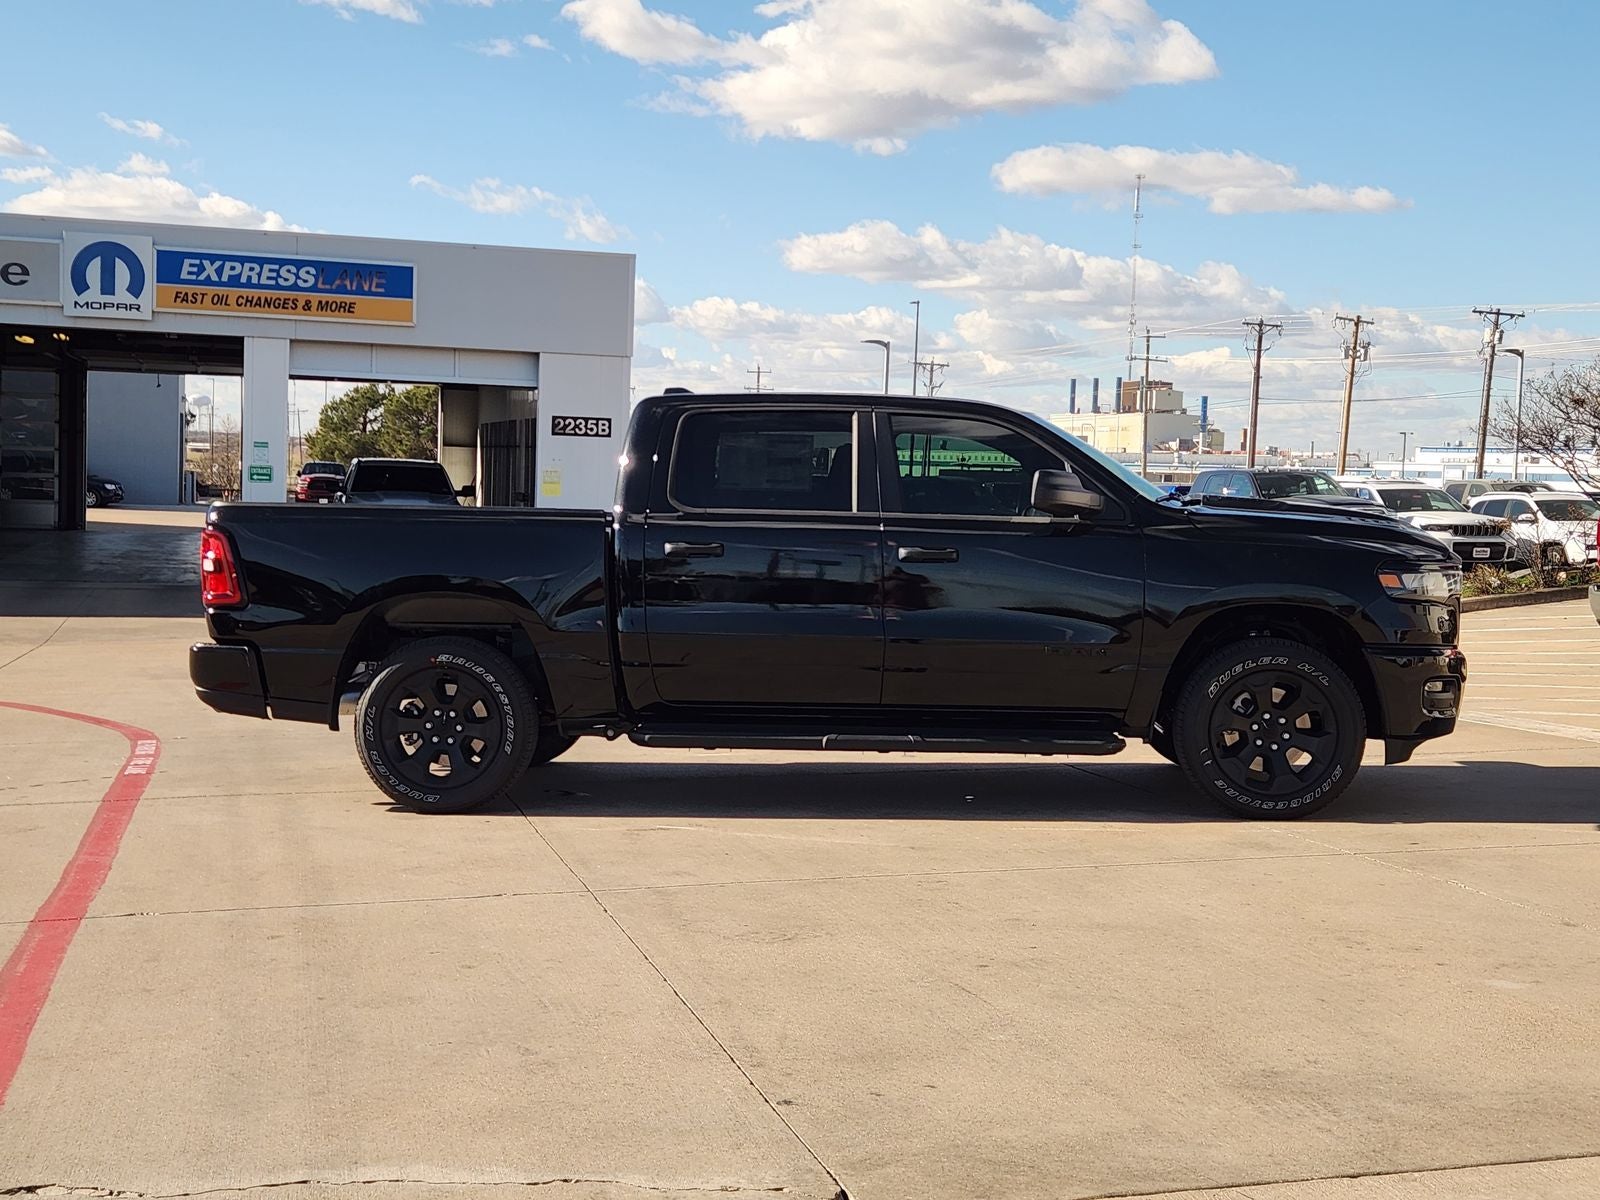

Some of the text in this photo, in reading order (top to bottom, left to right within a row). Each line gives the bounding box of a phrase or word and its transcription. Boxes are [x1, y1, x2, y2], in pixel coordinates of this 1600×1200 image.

[180, 258, 388, 293] EXPRESS LANE
[73, 300, 143, 313] MOPAR
[173, 291, 356, 314] FAST OIL CHANGES & MORE
[554, 418, 610, 436] 2235B
[1208, 656, 1289, 699] DUELER
[370, 750, 440, 803] DUELER
